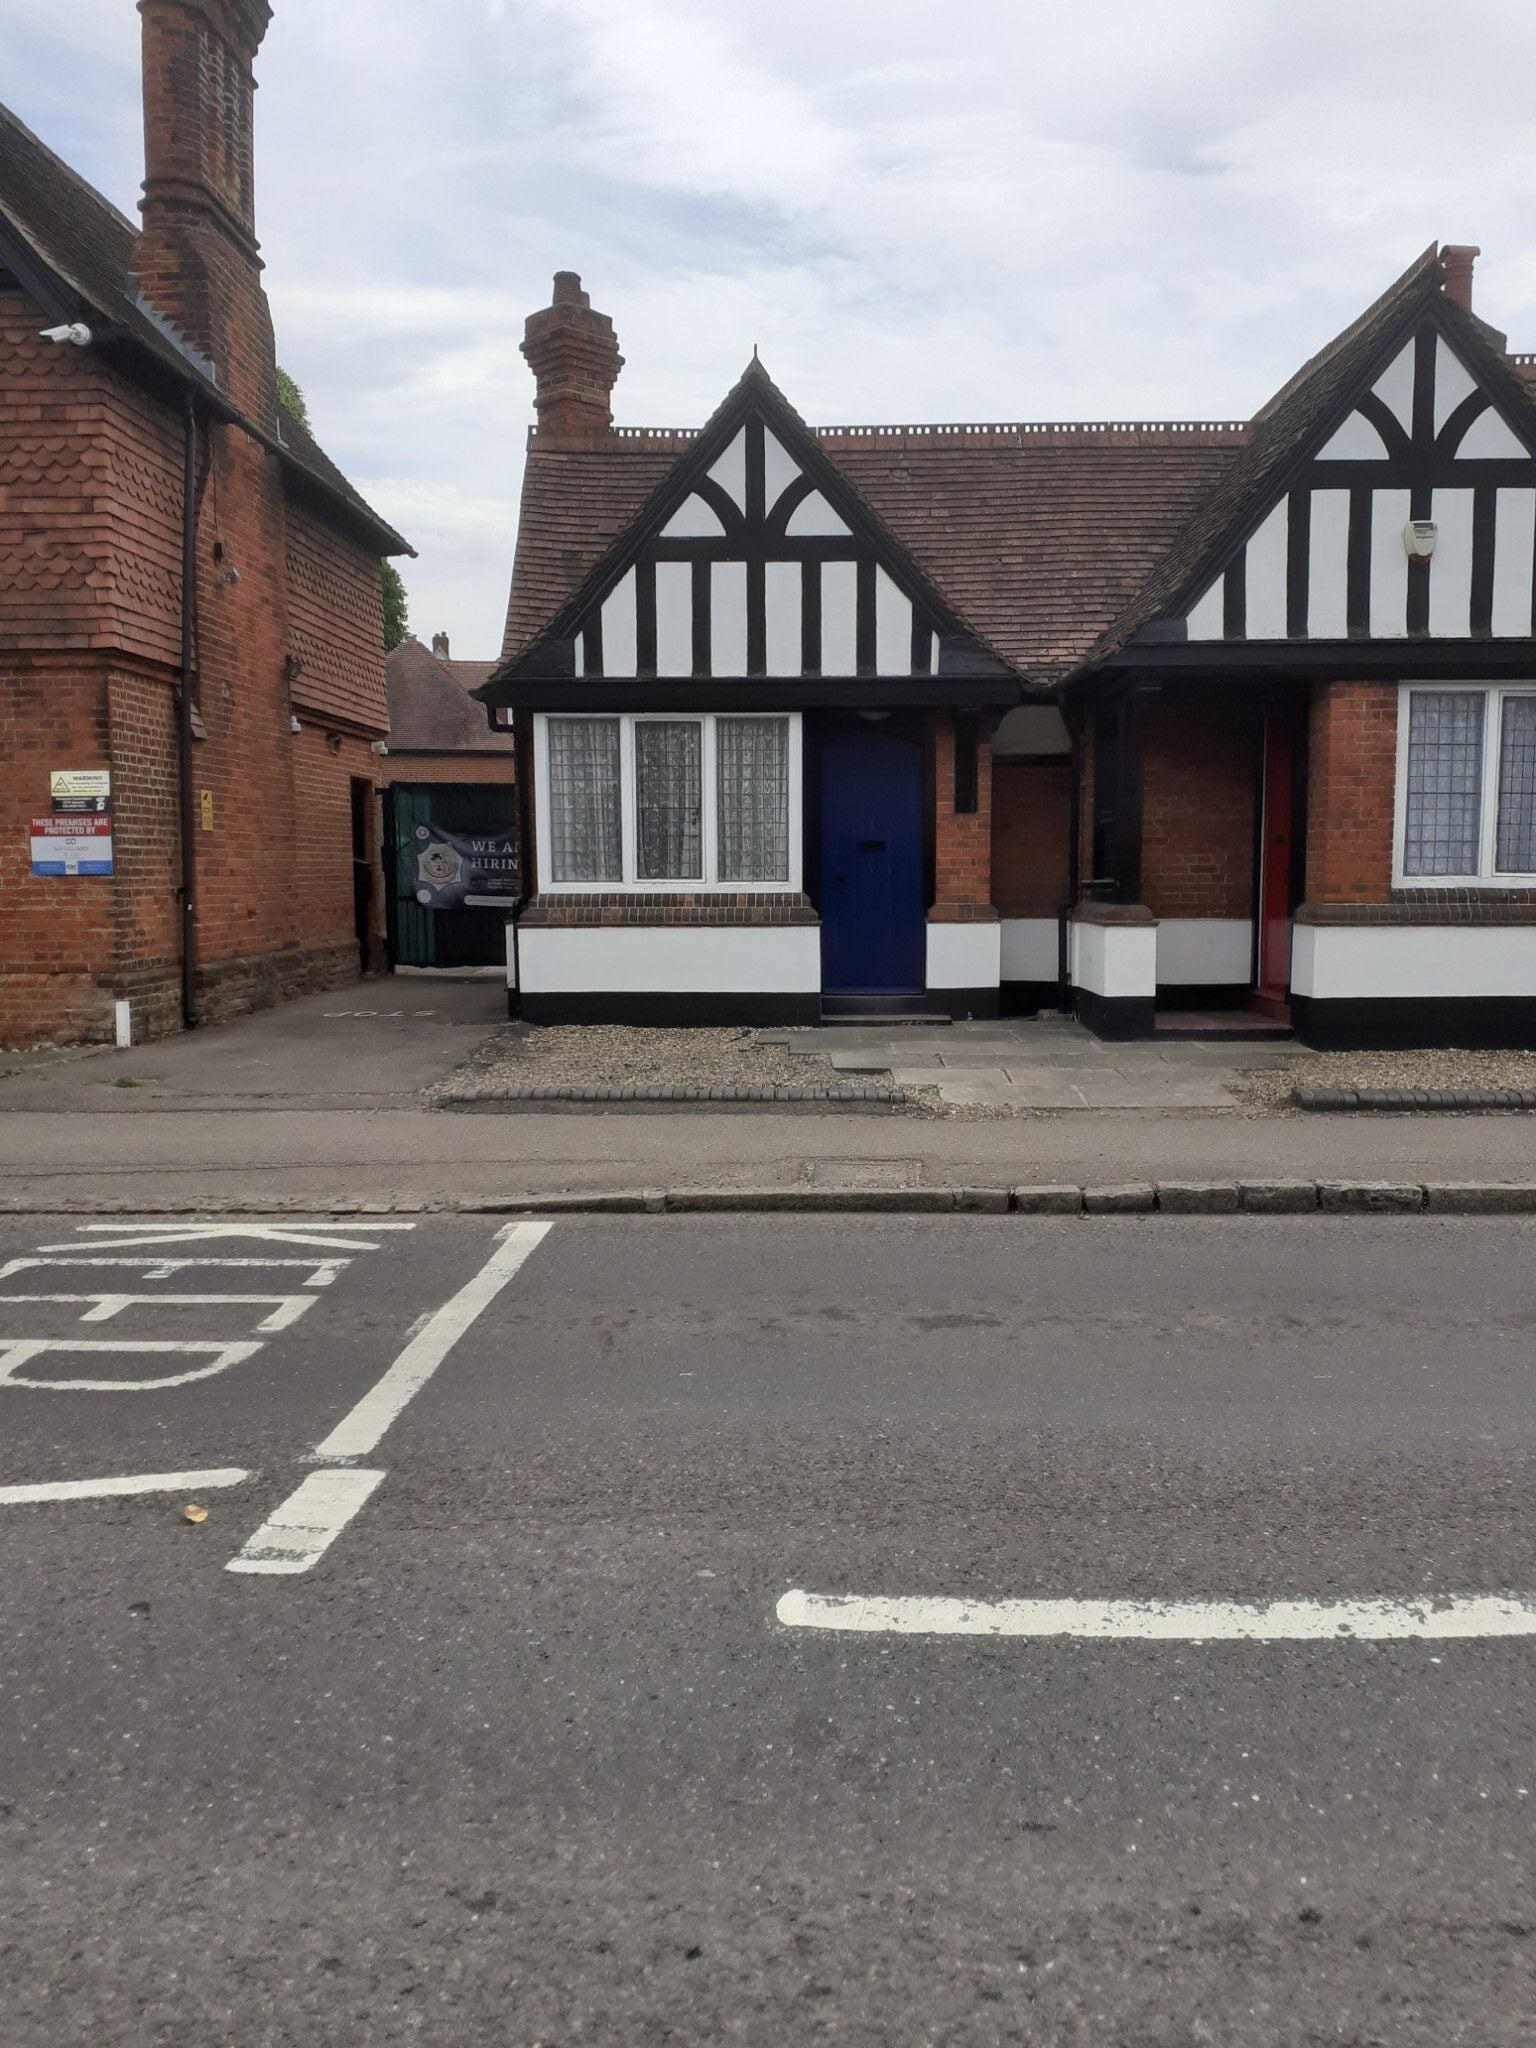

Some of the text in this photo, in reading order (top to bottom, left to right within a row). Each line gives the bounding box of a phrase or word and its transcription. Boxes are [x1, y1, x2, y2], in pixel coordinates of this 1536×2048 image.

[32, 818, 109, 826] THESE PREMISES ARE
[44, 826, 96, 834] PROTECTED BY
[472, 841, 496, 852] WE
